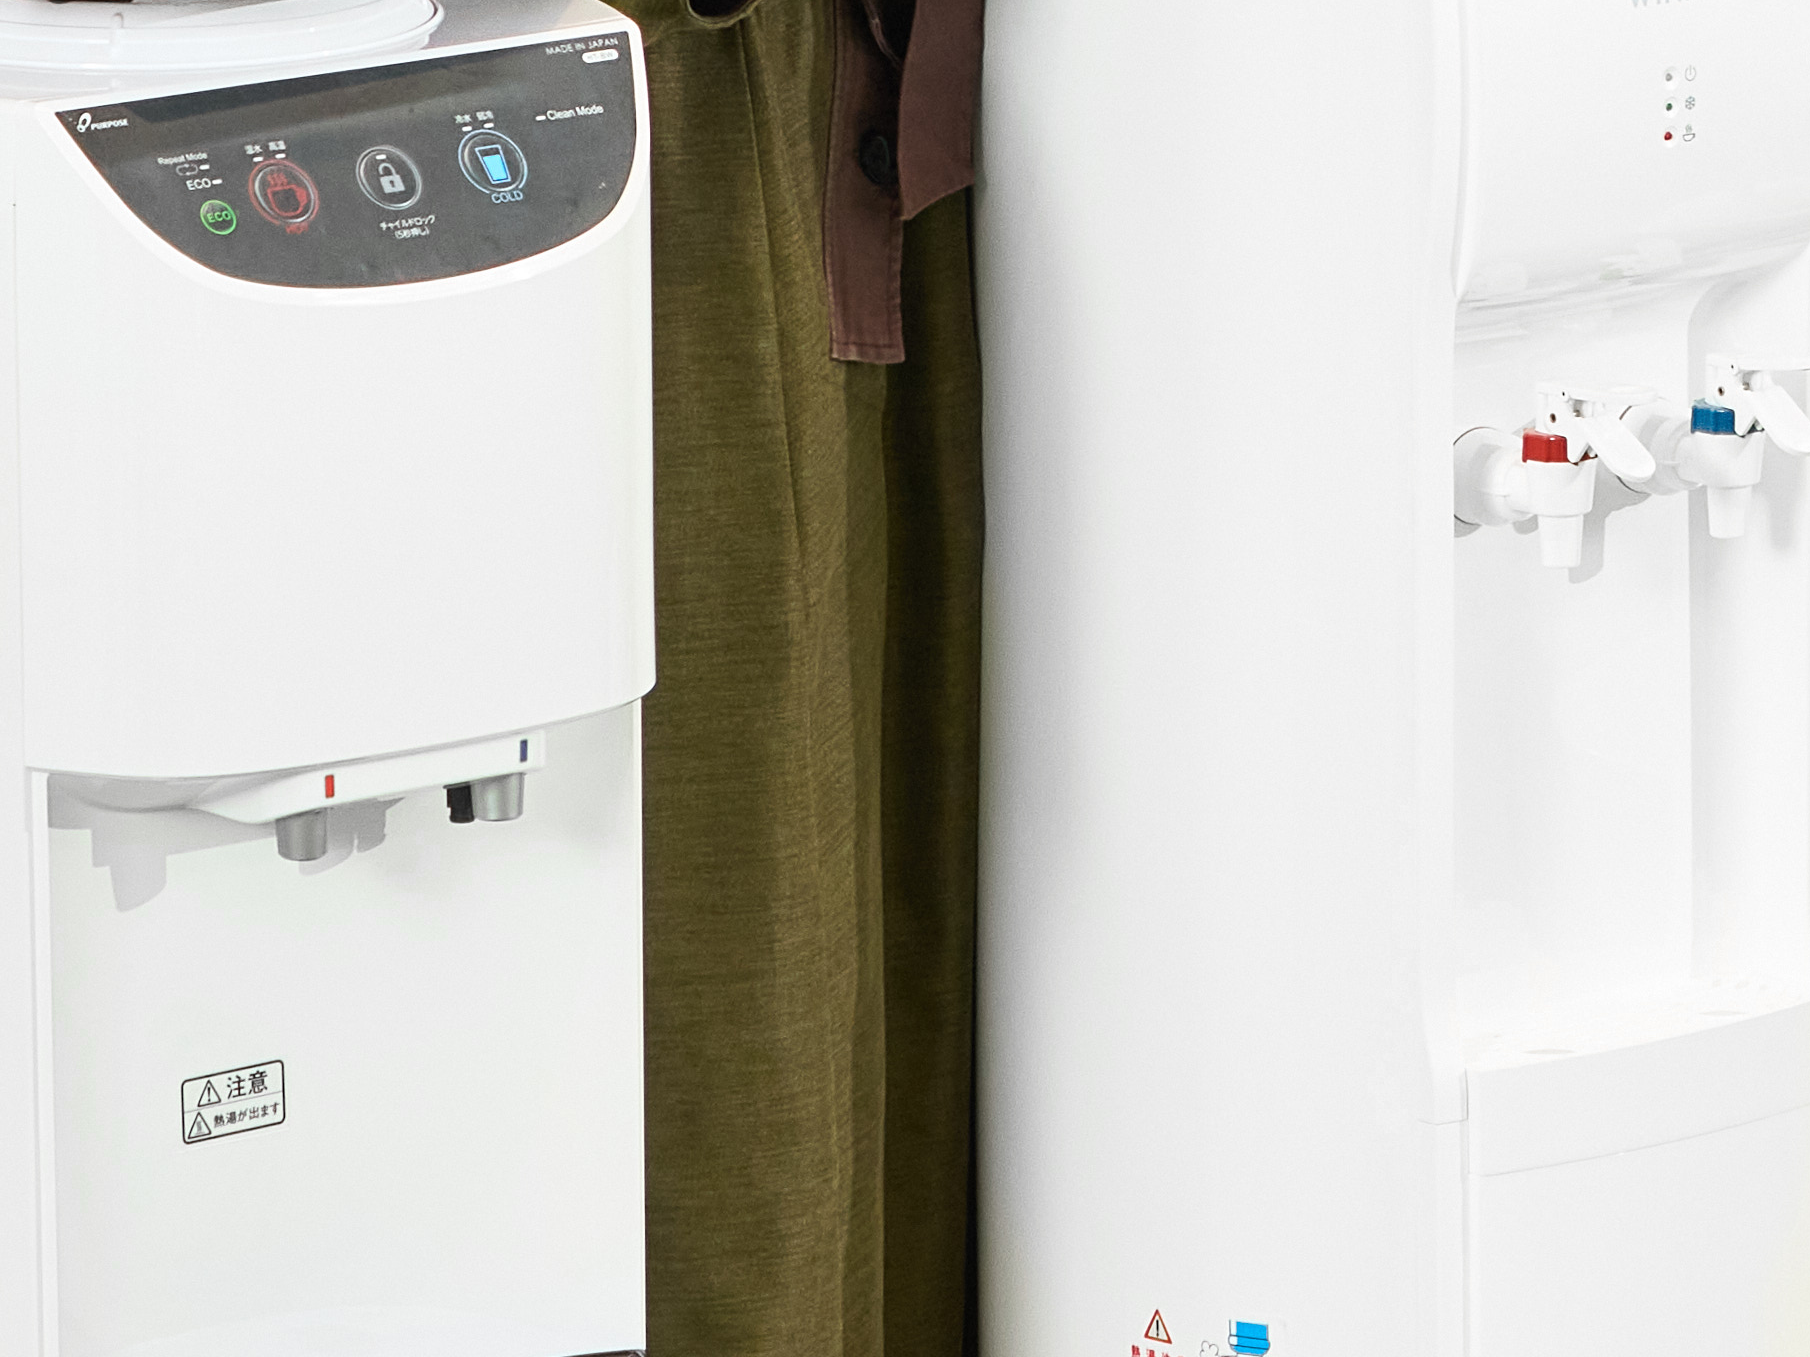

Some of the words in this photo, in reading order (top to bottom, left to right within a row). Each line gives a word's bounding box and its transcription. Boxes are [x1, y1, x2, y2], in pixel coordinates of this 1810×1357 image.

[545, 43, 574, 56] MADE
[588, 37, 619, 49] JAPAN
[546, 107, 576, 121] Clean
[576, 103, 604, 117] Mode
[157, 153, 185, 166] Repeat
[185, 151, 208, 163] Mode
[185, 178, 212, 191] ECO
[490, 189, 524, 205] COLD
[206, 210, 232, 224] ECO
[226, 1069, 268, 1100] 注意
[213, 1101, 281, 1129] 熱湯が出ます
